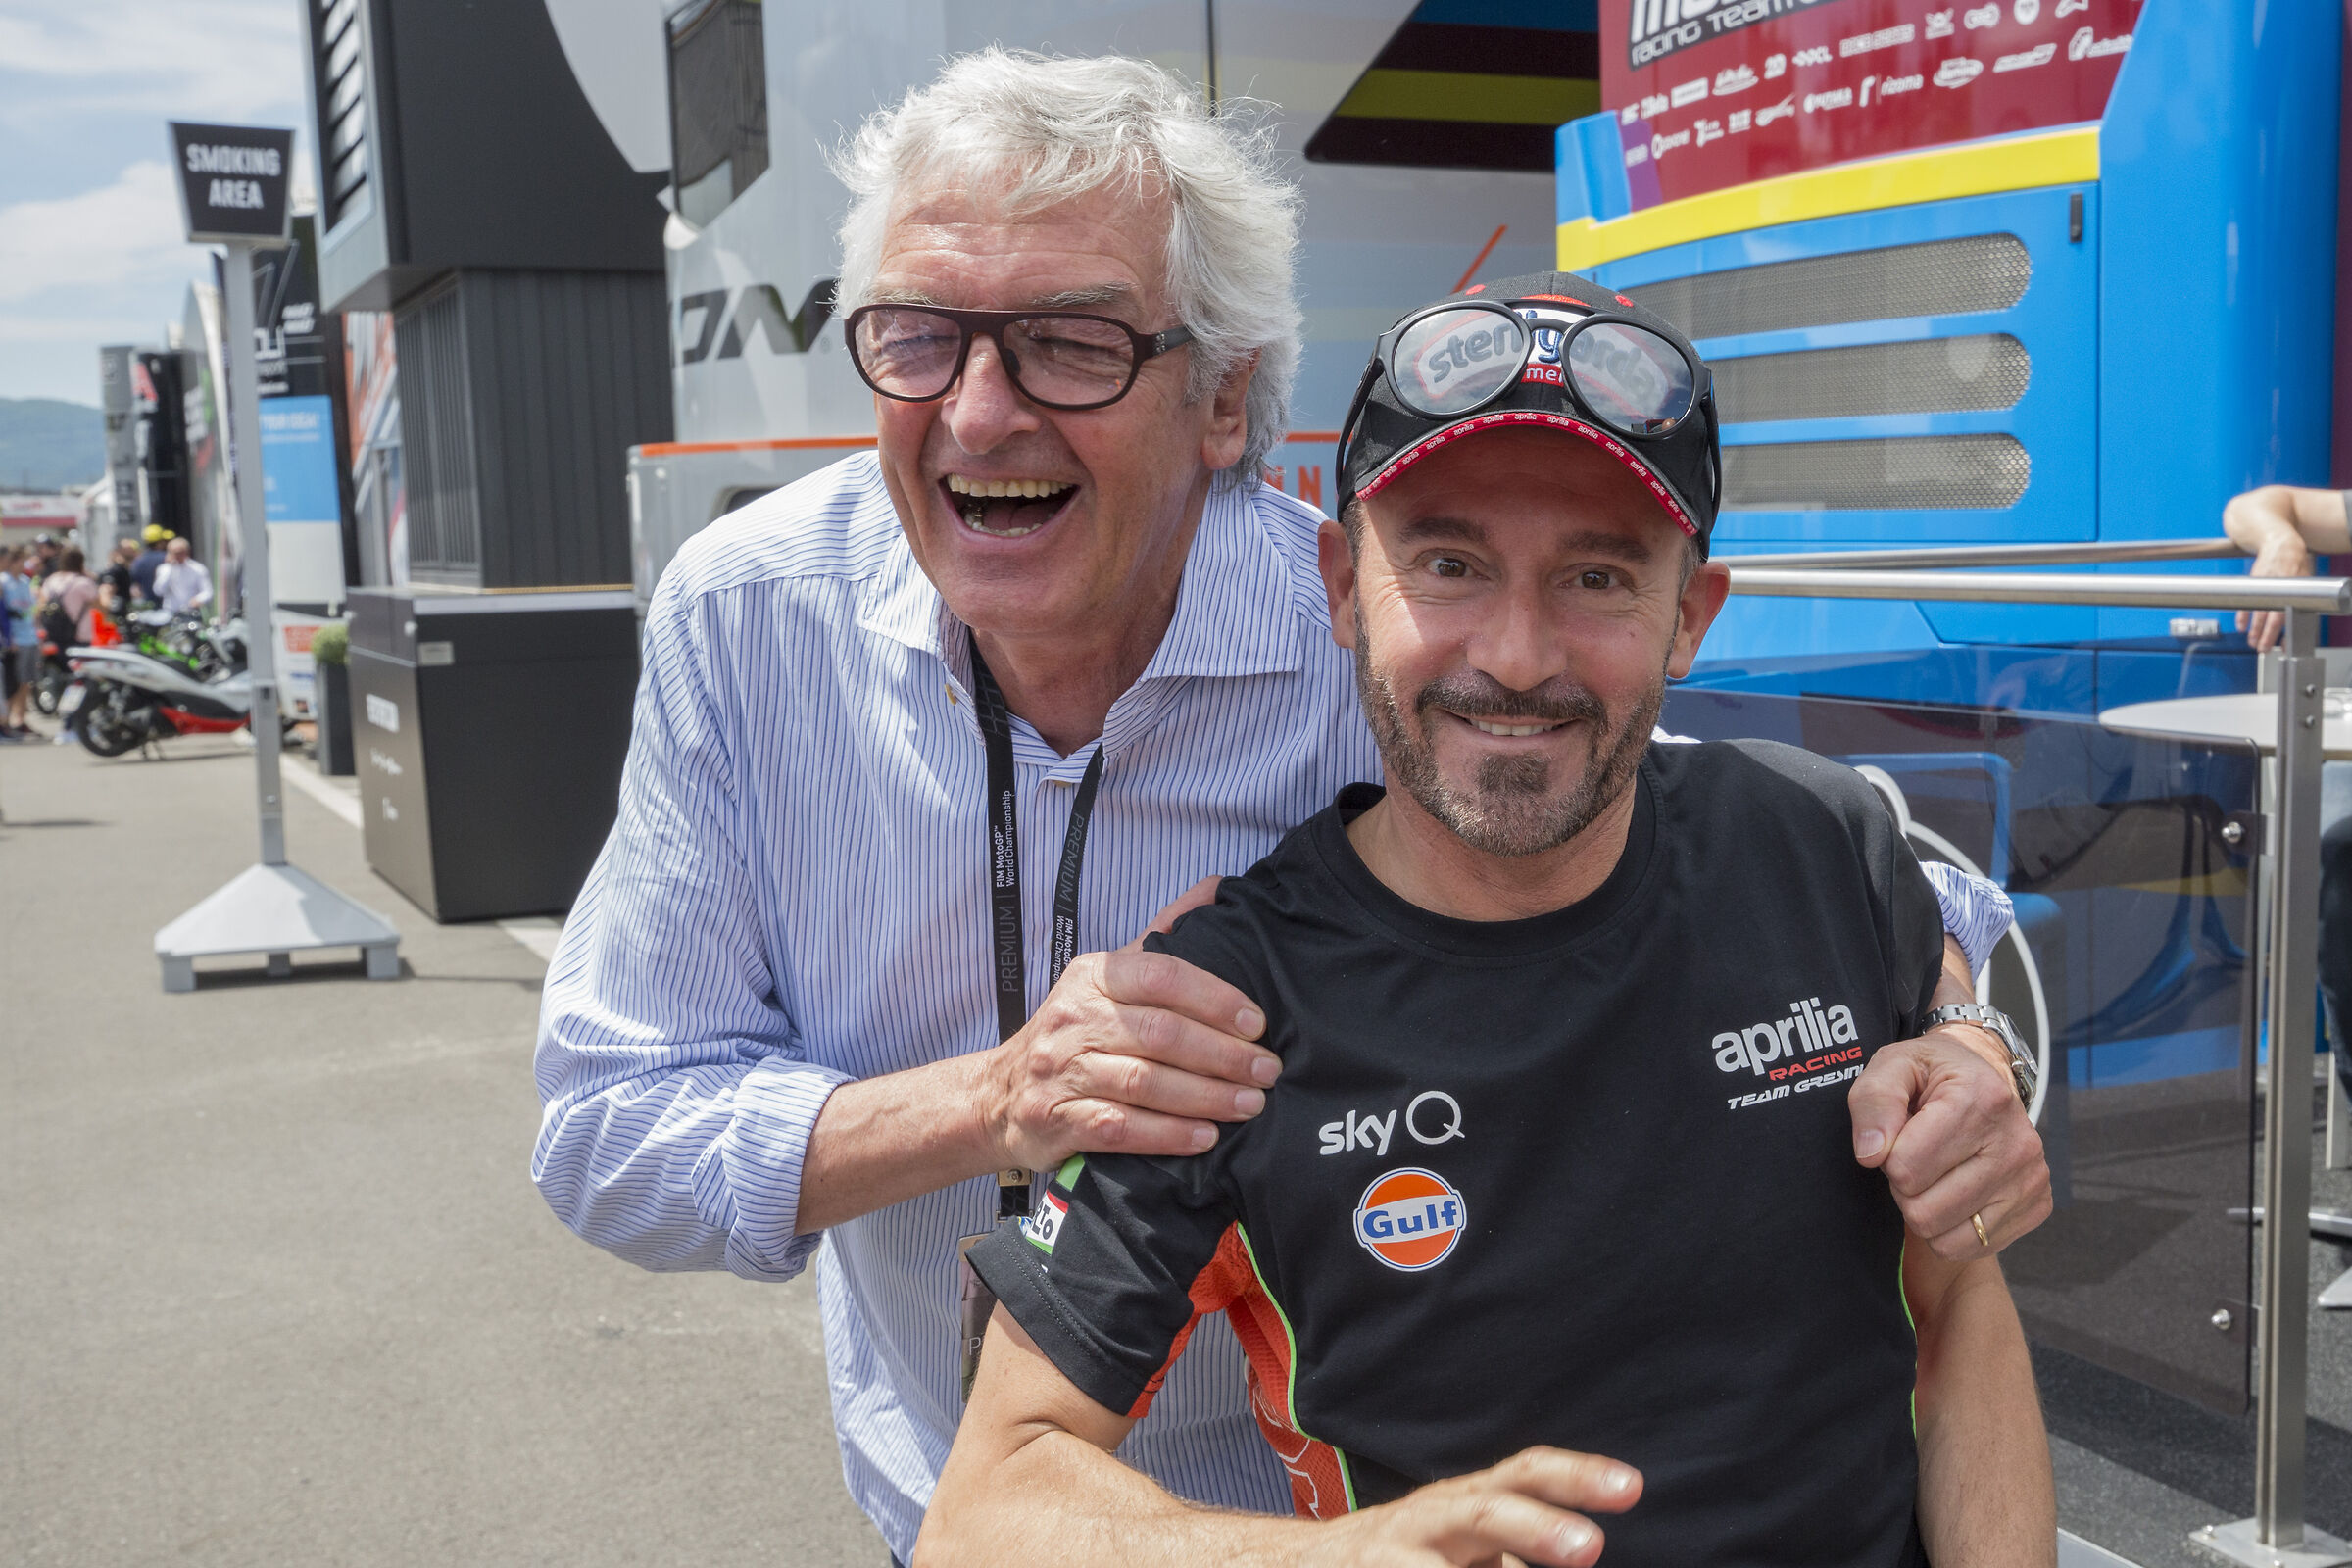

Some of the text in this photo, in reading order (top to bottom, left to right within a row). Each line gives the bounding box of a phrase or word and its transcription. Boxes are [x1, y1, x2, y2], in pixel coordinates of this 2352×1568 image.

[186, 143, 281, 176] SMOKING
[208, 178, 264, 209] AREA
[1002, 790, 1015, 887] World Championship
[1059, 812, 1085, 902] PREMIUM
[996, 869, 1005, 888] FIM
[1056, 915, 1065, 941] World
[1000, 906, 1018, 992] PREMIUM
[1712, 997, 1859, 1076] aprilia
[1769, 1047, 1863, 1081] RACING
[1728, 1085, 1790, 1109] TEAM
[1318, 1091, 1465, 1156] sky Q
[1363, 1201, 1457, 1239] Gulf
